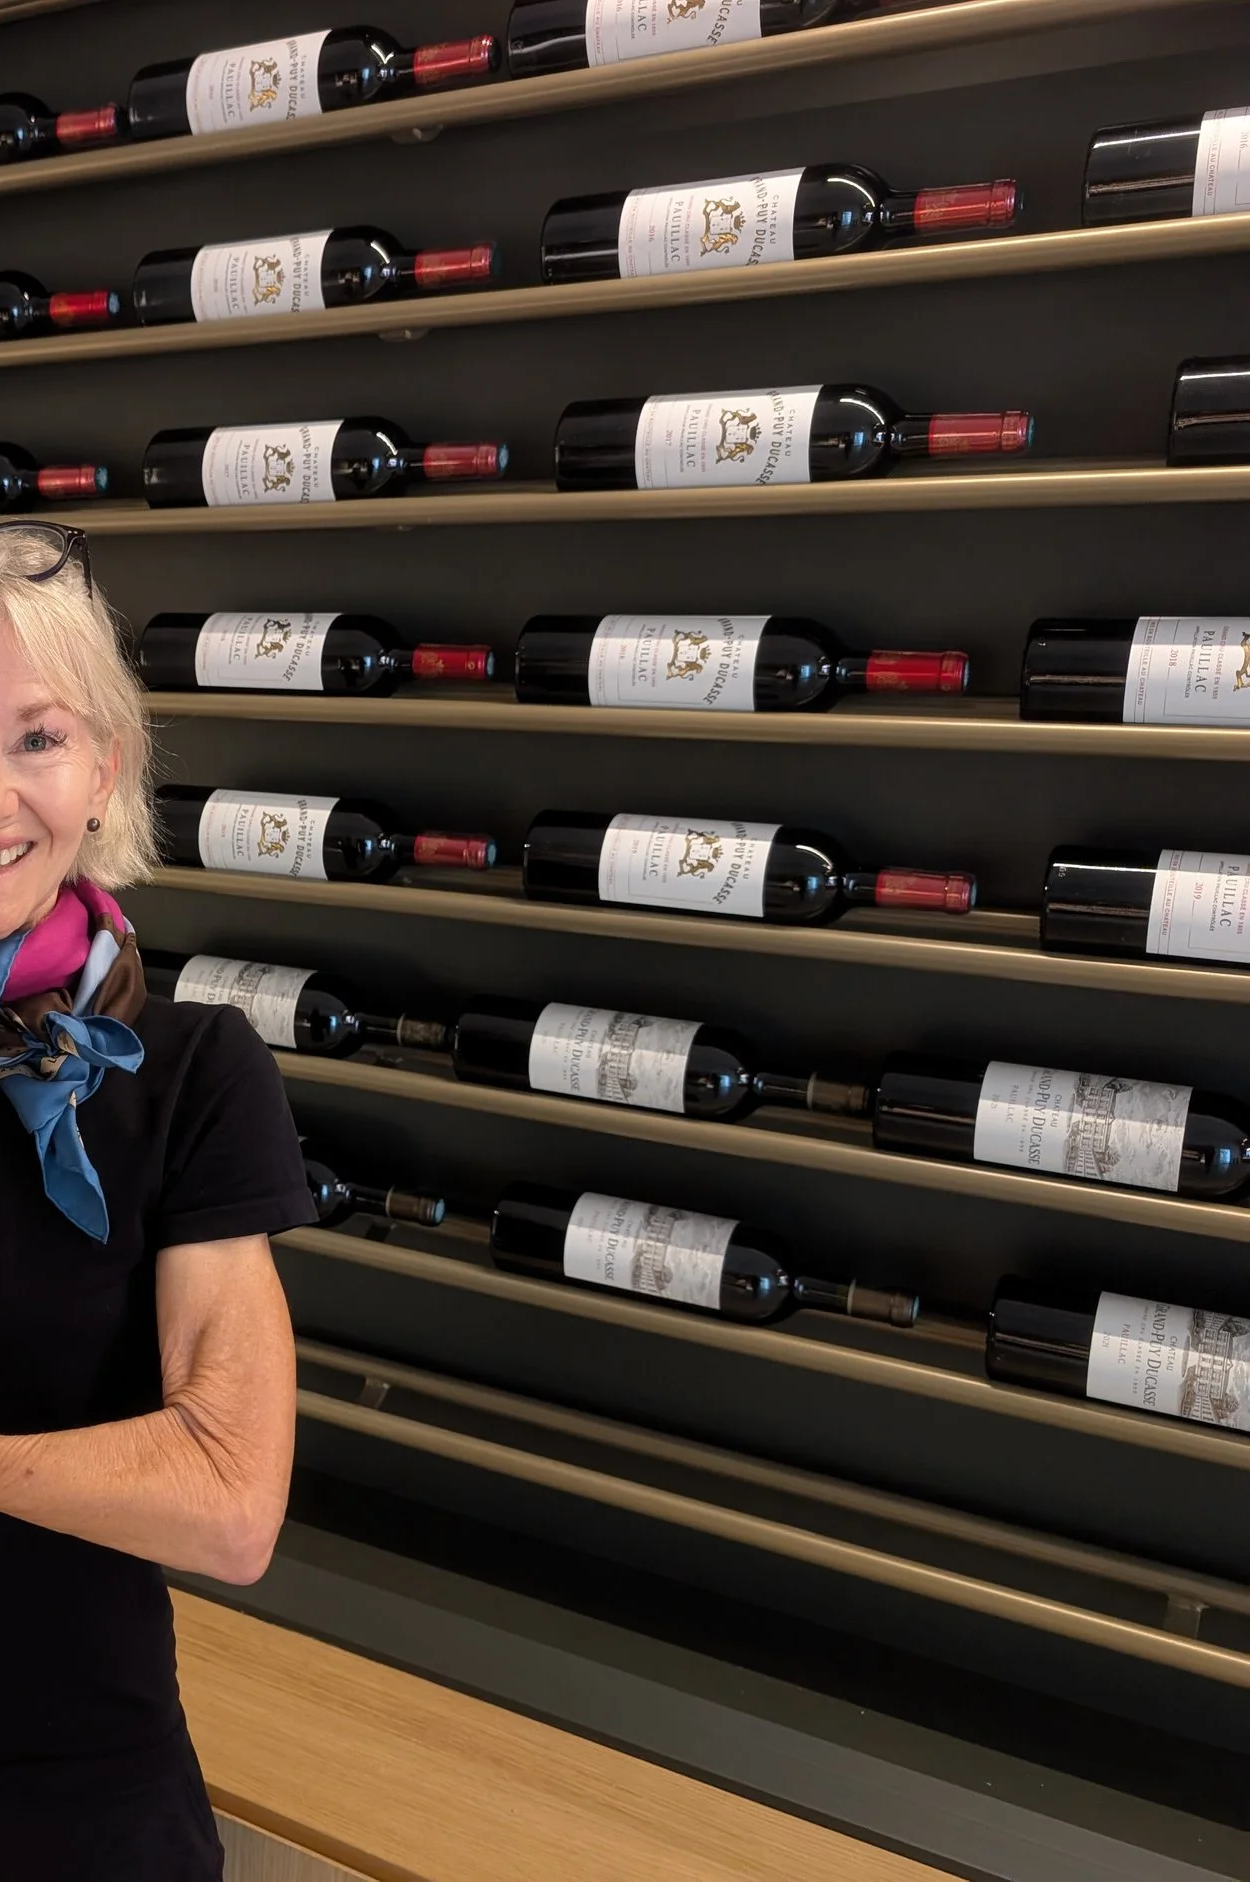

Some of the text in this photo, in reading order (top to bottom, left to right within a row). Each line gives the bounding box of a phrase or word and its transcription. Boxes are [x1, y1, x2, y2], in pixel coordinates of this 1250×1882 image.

[707, 0, 731, 44] UCASSE
[225, 63, 236, 118] PAUILLAC
[286, 85, 297, 120] DUCAS
[670, 201, 684, 263] PAUILLAC
[769, 194, 779, 245] CHATEAU
[746, 229, 766, 266] DUCAS
[230, 257, 240, 309] PAUILLAC
[291, 284, 302, 313] DUCAS
[665, 429, 673, 447] 2017
[685, 409, 701, 468] PAUILLAC
[784, 409, 796, 457] CHATEAU
[240, 444, 251, 495] PAUILLAC
[301, 475, 310, 504] DUCAS
[638, 628, 656, 682] PAUILLAC
[732, 634, 744, 679] CHATEAU
[1168, 649, 1179, 667] 2018
[1194, 630, 1216, 693] PAUILLAC
[703, 663, 730, 705] DUCASSE
[1138, 678, 1146, 706] CHATEAU
[236, 809, 249, 857] PAUILLAC
[650, 825, 669, 877] PAUILLAC
[743, 837, 757, 880] CHATEAU
[712, 864, 741, 905] DUCASSE
[1193, 882, 1203, 900] 2019
[1219, 866, 1240, 927] PAUILLAC
[1162, 908, 1170, 936] CHATEAU
[570, 1047, 584, 1091] DUCASSE
[1005, 1084, 1019, 1123] PAUILLAC
[1050, 1094, 1062, 1128] CHATEAU
[1029, 1116, 1046, 1165] DUCASSE
[1118, 1323, 1130, 1364] PAUILLAC
[1143, 1303, 1170, 1407] GRAND-PUY DUCASSE
[1166, 1335, 1178, 1372] CHATEAU
